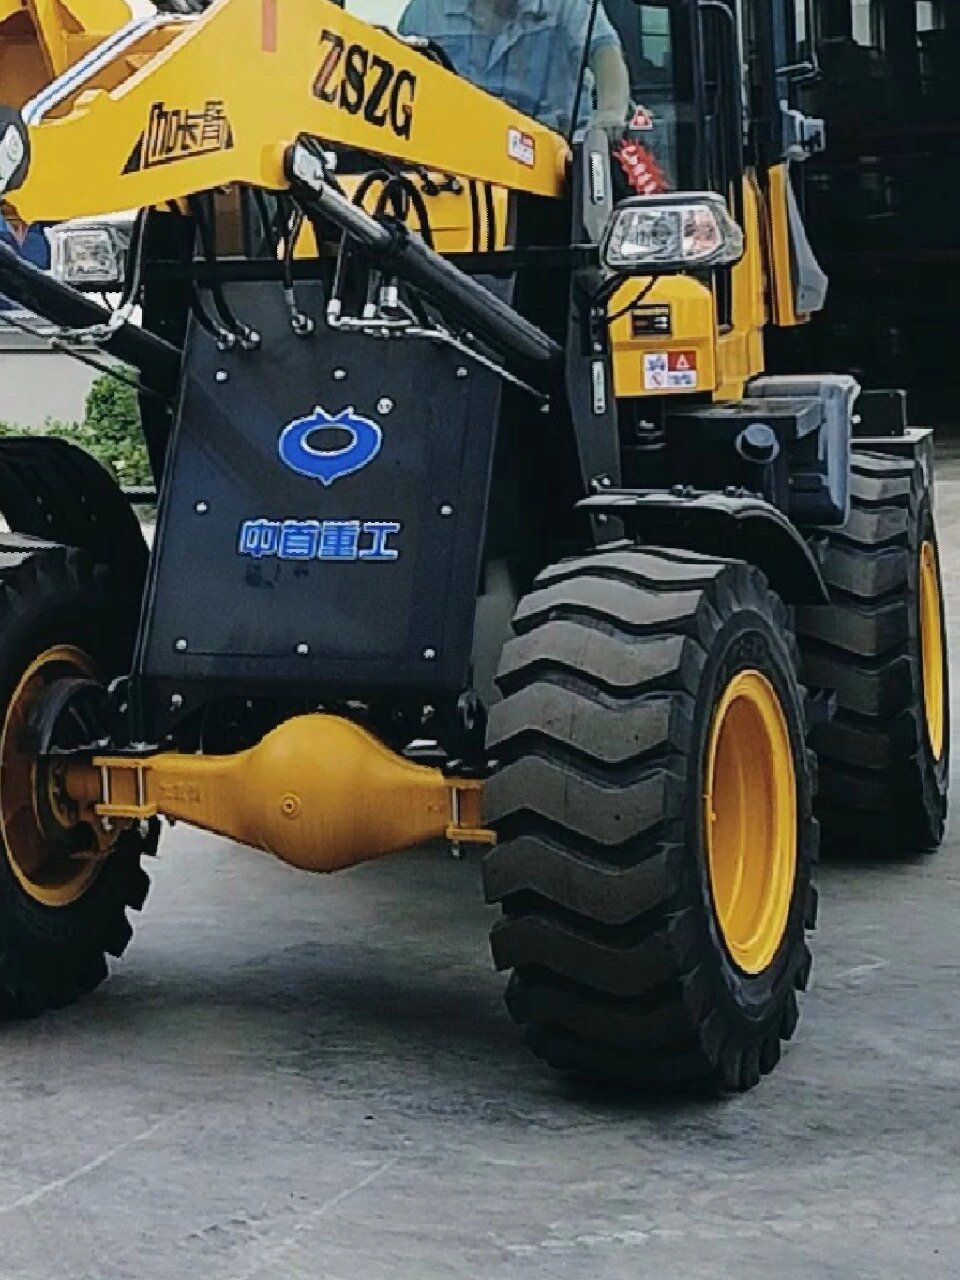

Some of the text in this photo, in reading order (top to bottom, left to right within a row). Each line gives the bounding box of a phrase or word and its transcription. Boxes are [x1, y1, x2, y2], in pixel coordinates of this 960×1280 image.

[312, 28, 416, 141] ZSZG
[238, 519, 401, 560] 中首重工
